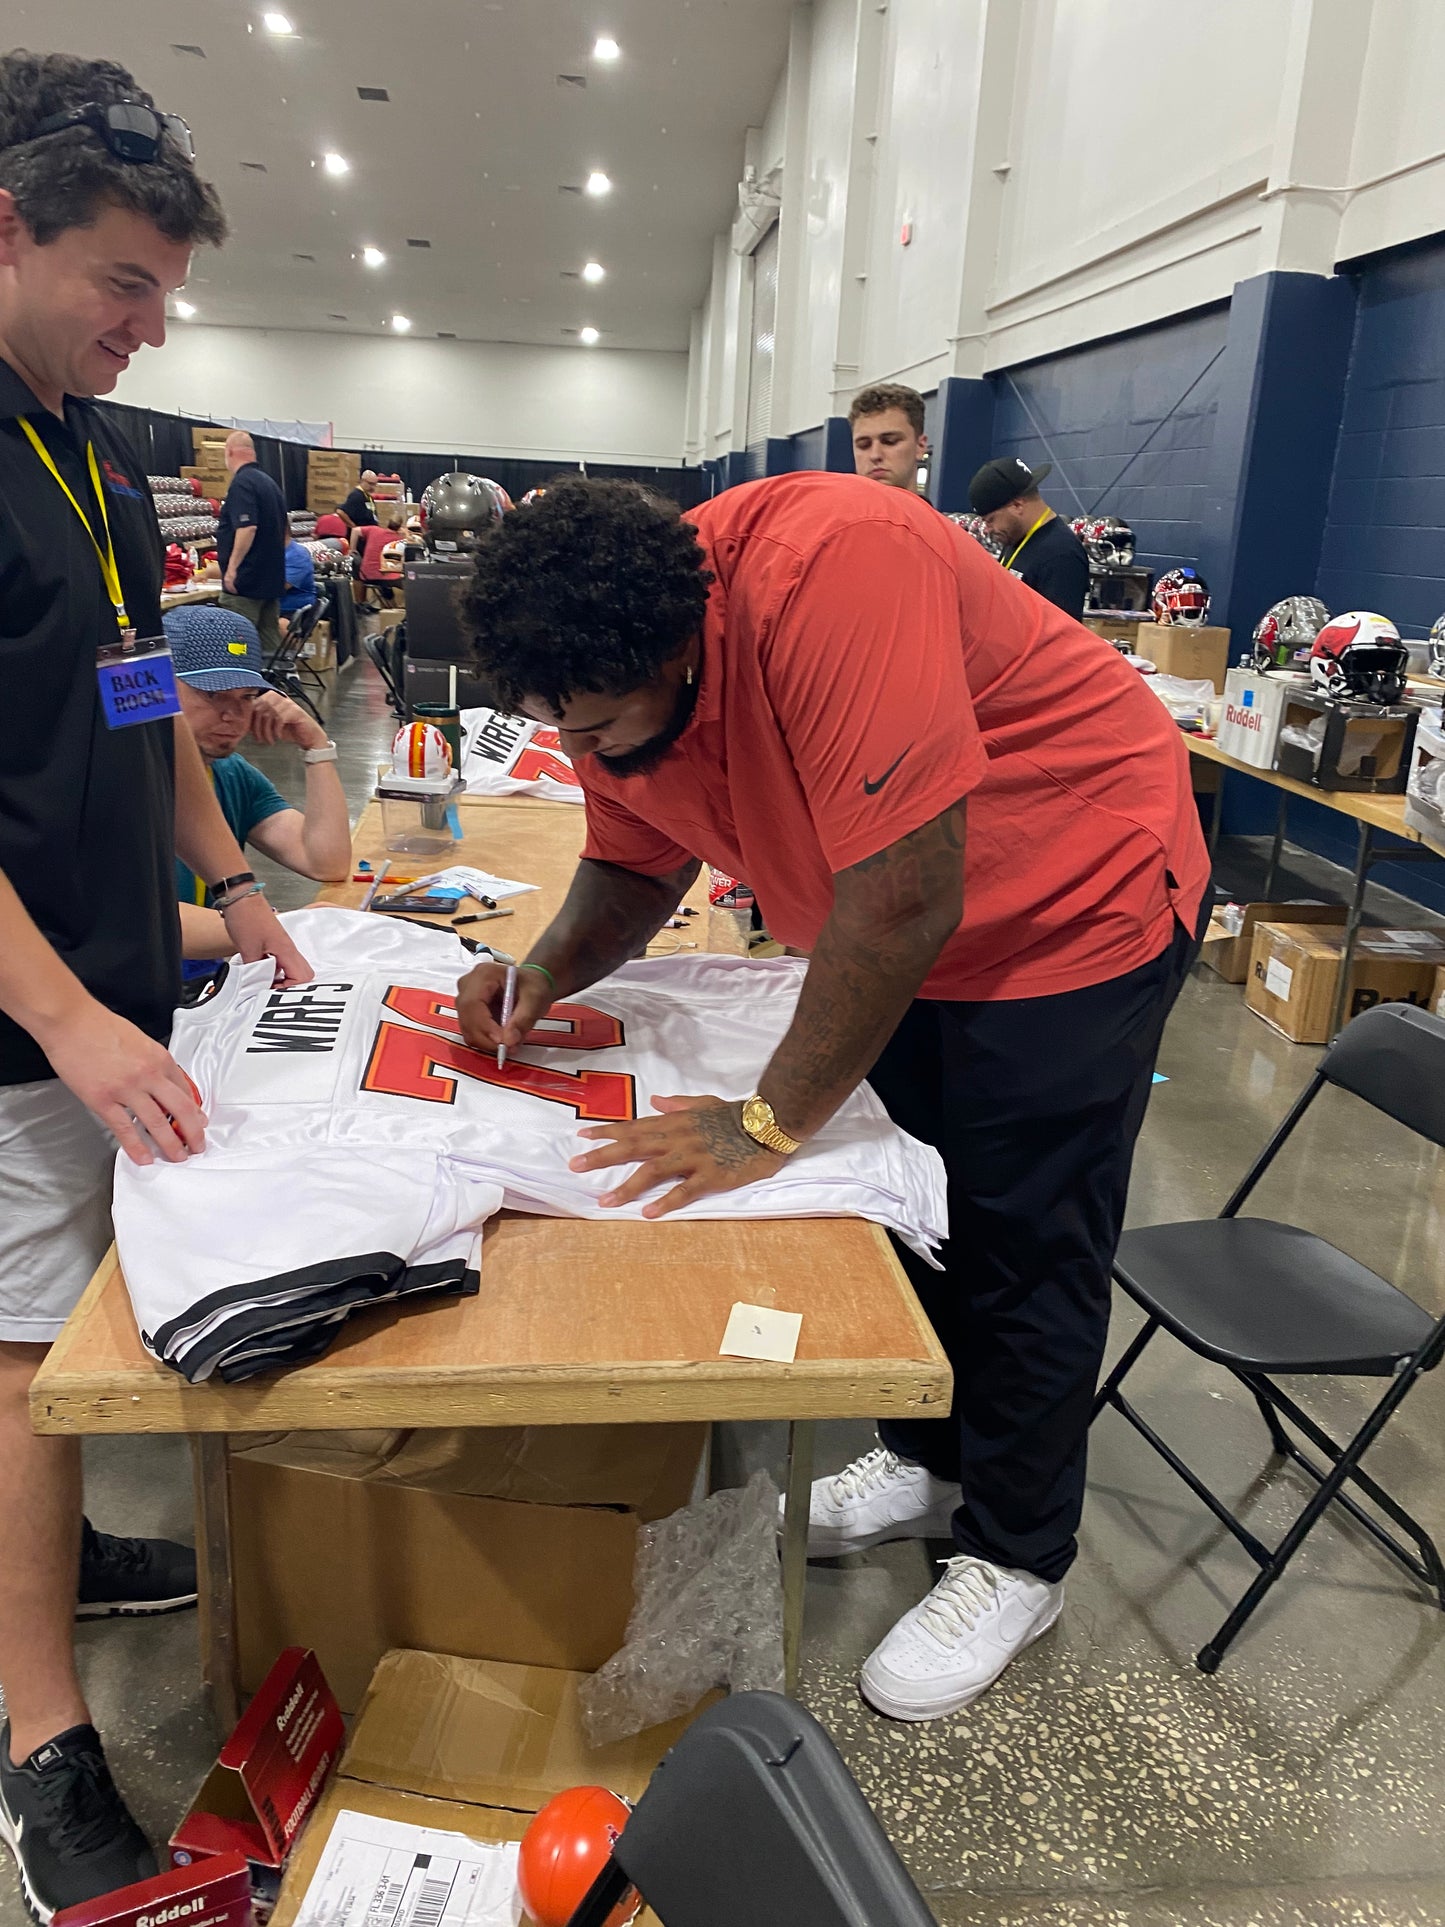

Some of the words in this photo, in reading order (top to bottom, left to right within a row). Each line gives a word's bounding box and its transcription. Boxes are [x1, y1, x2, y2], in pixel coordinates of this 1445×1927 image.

[111, 670, 159, 692] BACK
[114, 688, 166, 713] ROOM
[1226, 704, 1262, 732] Riddell
[508, 730, 581, 787] 7
[246, 983, 354, 1053] WIRFS
[277, 1683, 304, 1732] Riddell
[284, 1787, 312, 1838] FOOTBALL
[369, 1904, 380, 1913] FL
[373, 1890, 385, 1903] 336
[136, 1897, 204, 1927] Riddell
